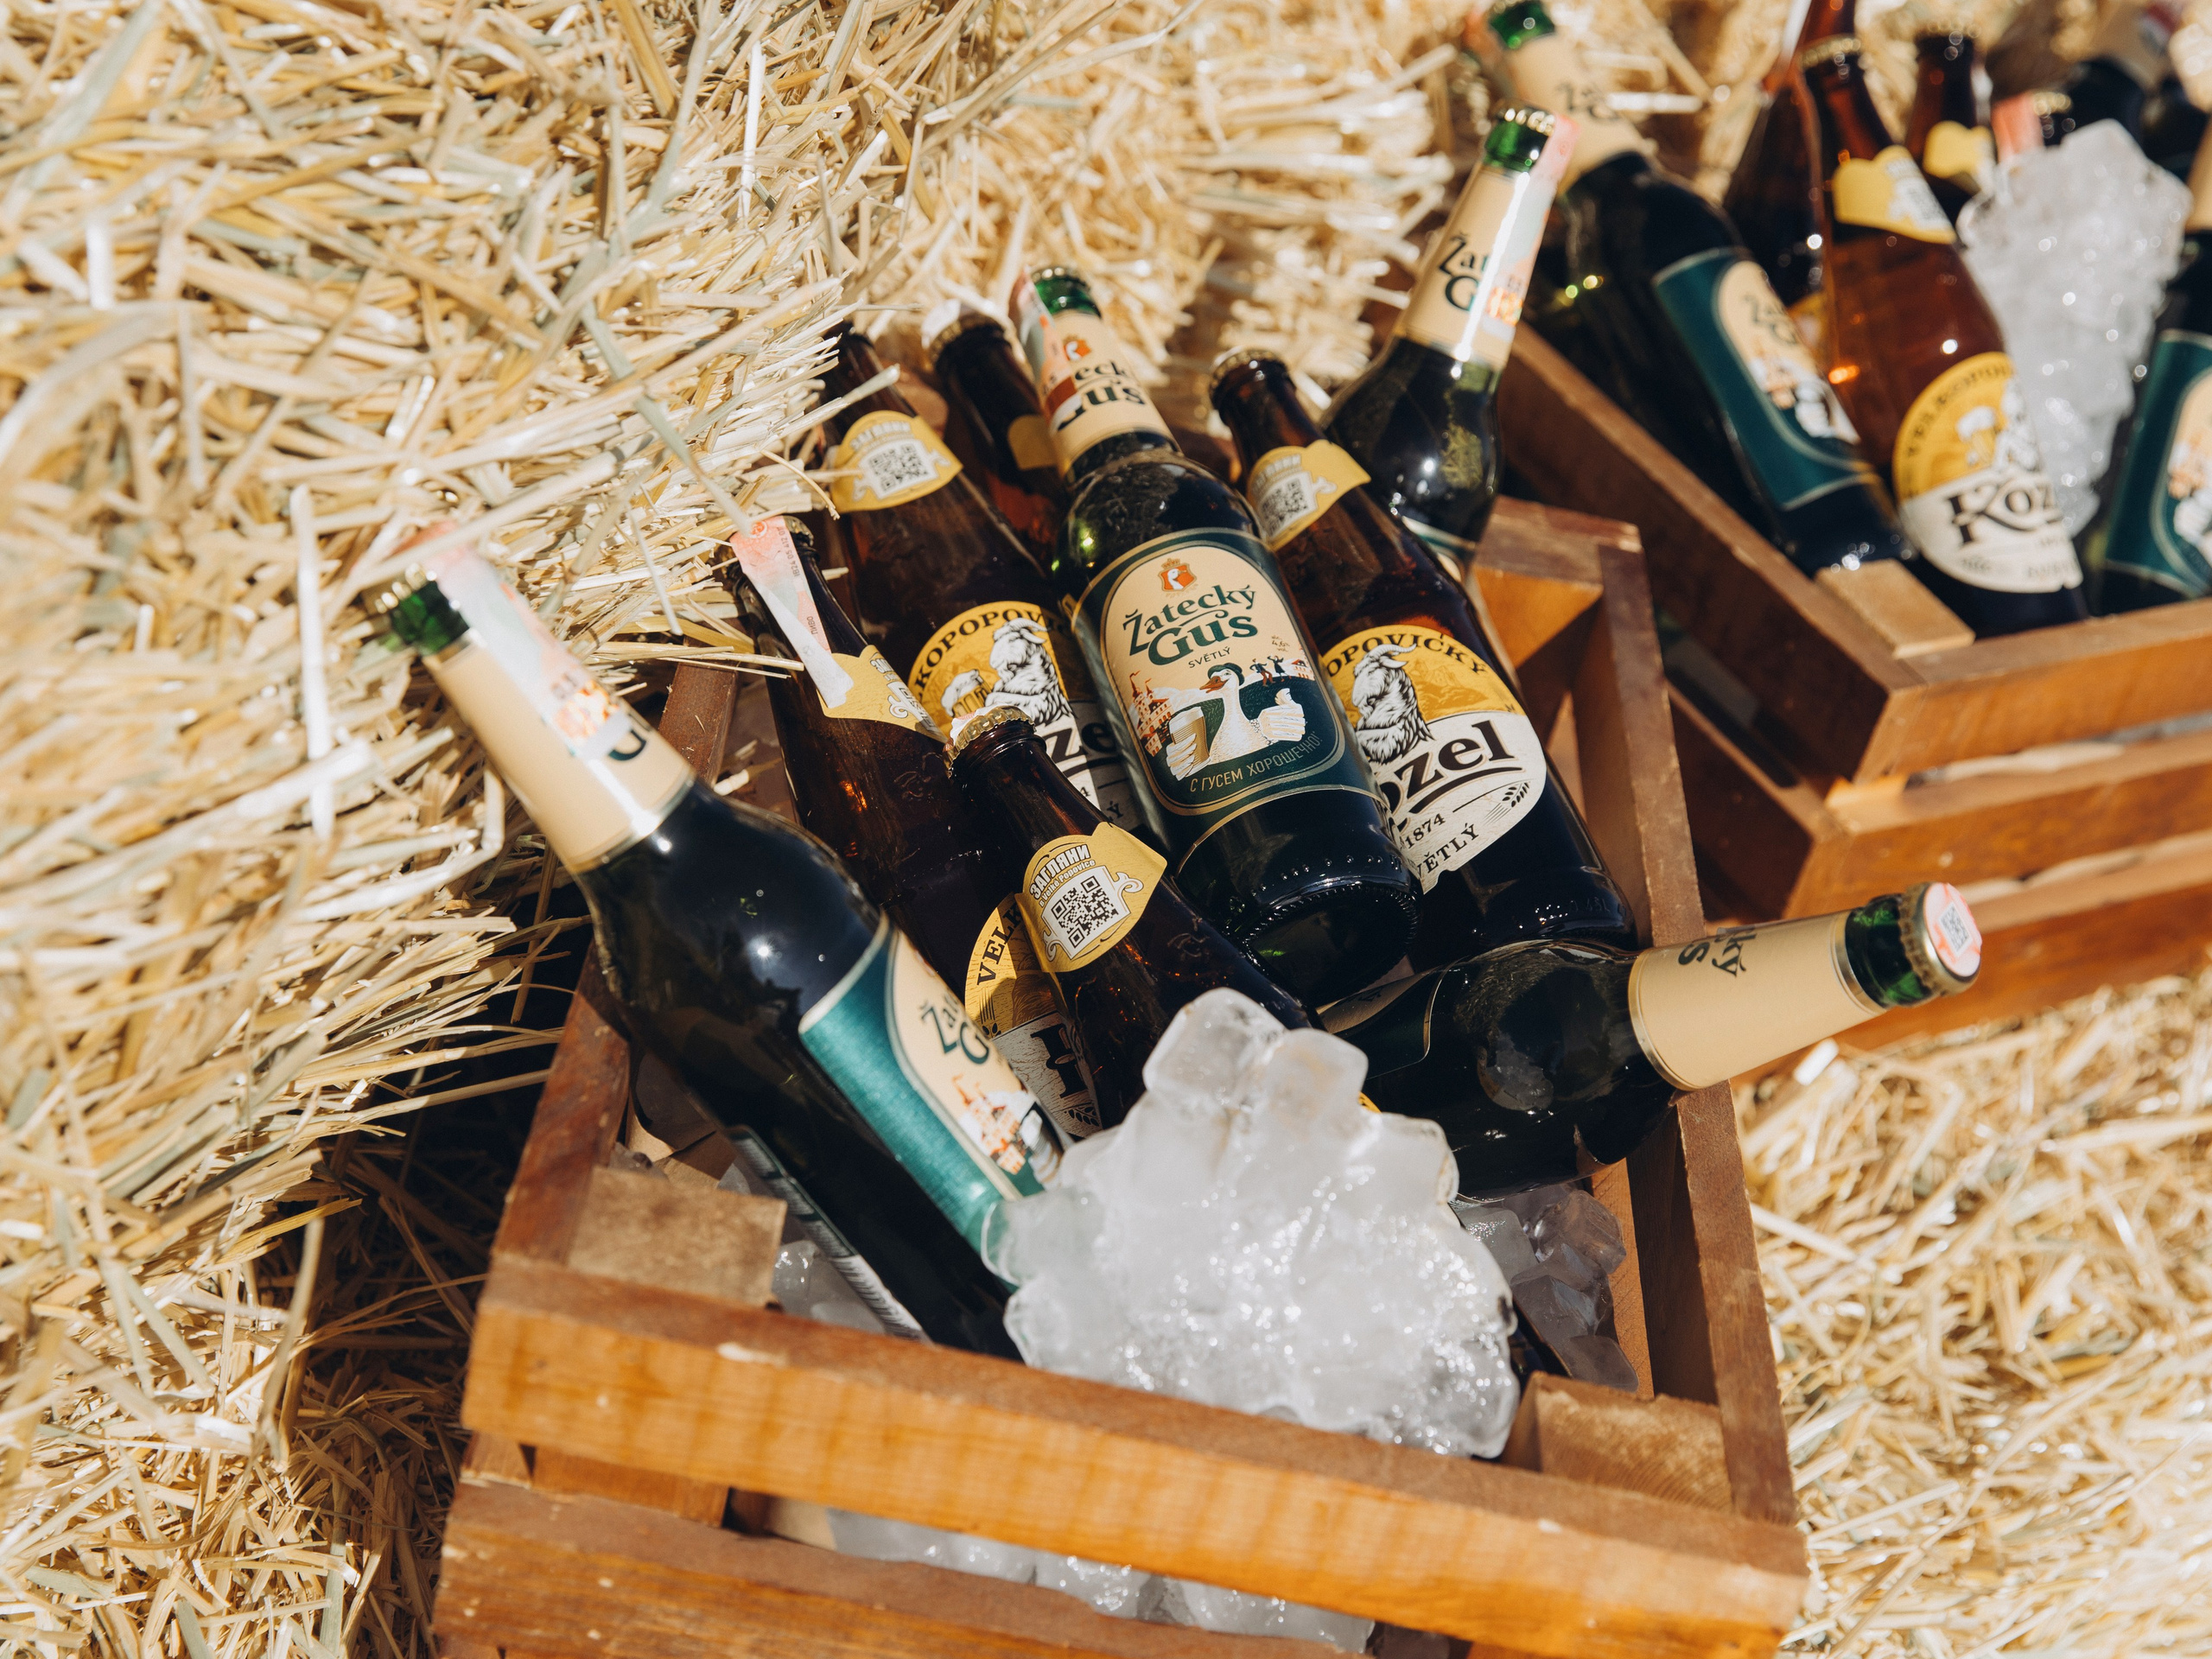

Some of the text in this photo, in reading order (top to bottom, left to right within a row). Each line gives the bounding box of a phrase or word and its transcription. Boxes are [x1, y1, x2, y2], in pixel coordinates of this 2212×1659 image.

[806, 616, 818, 635] ПИВО
[1122, 585, 1256, 657] Žatecký
[1147, 612, 1258, 665] Gus
[1188, 647, 1231, 669] SVĚTLÝ
[1190, 778, 1198, 792] С
[1201, 768, 1243, 791] ГУСЕМ
[1405, 813, 1446, 849] 1874
[1029, 844, 1091, 899] ЗАГЛЯНИ
[1058, 860, 1096, 883] Popovice
